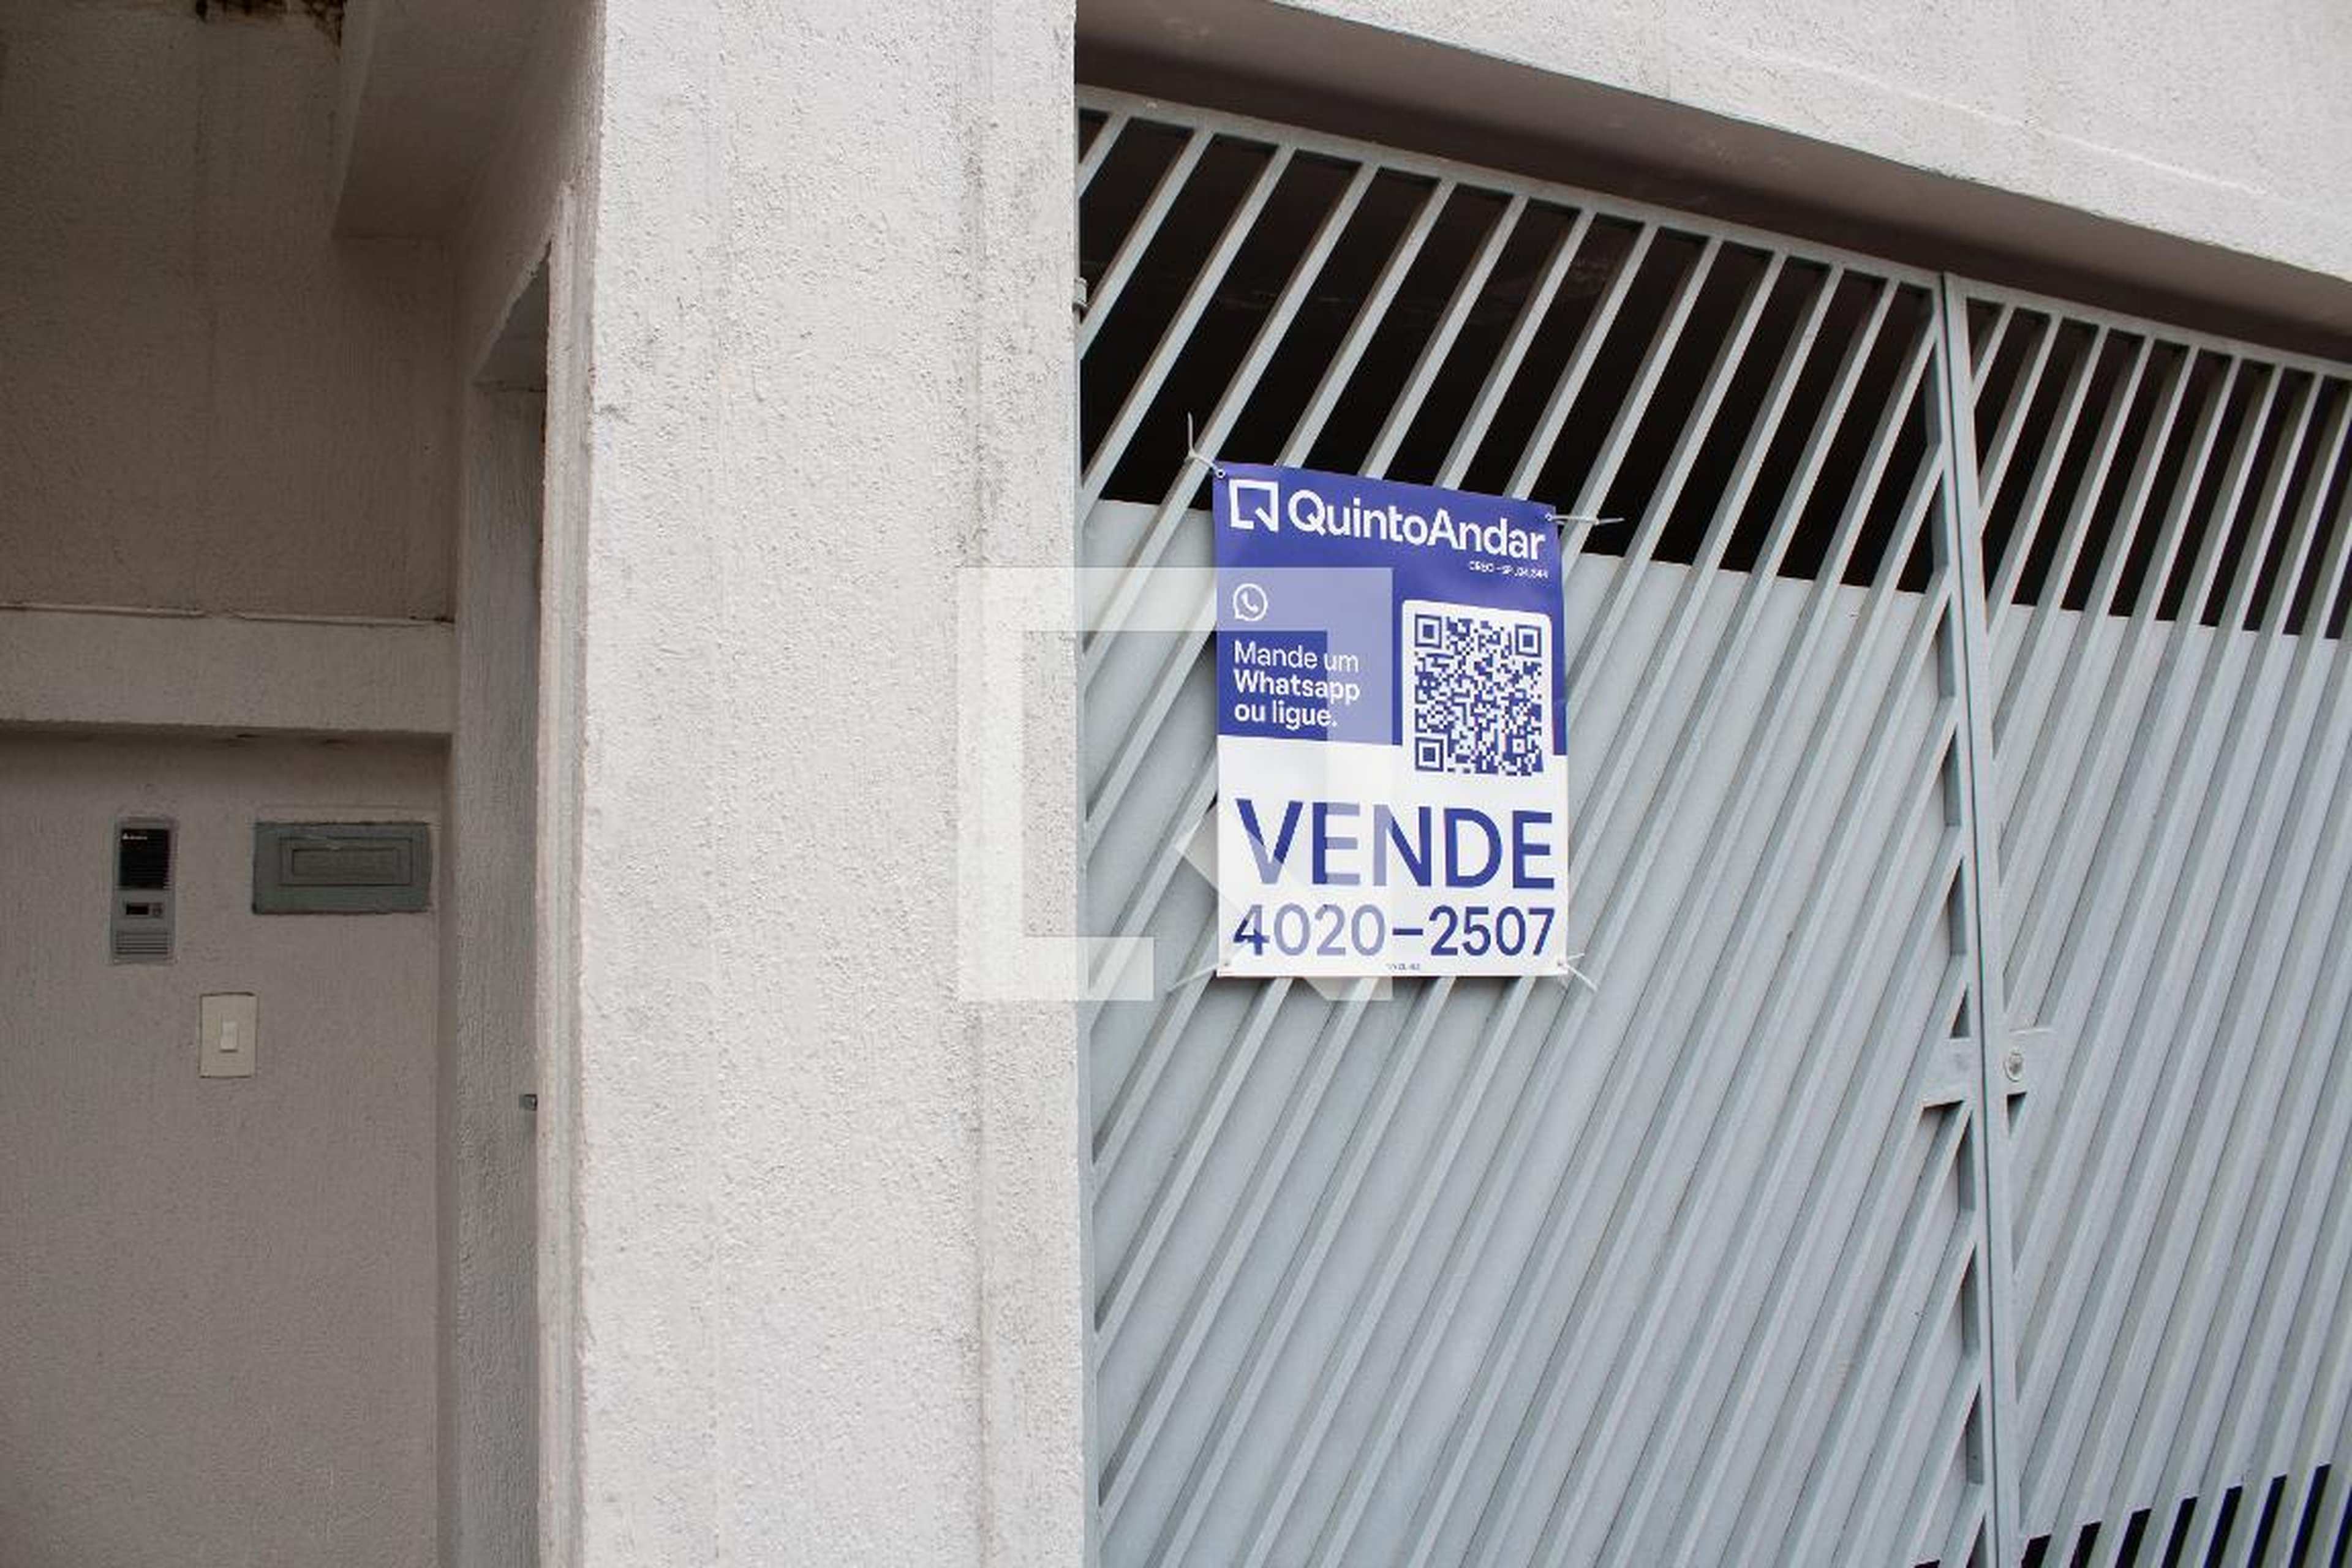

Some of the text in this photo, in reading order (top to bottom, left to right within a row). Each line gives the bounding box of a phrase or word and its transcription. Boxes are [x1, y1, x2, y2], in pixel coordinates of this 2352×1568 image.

[1287, 489, 1547, 560] QuintoAndar
[1234, 640, 1359, 673] Mande um
[1234, 668, 1360, 706] Whatsapp
[1234, 699, 1338, 730] ou ligue.
[1235, 797, 1555, 889] VENDE
[1232, 903, 1556, 957] 4020-2507
